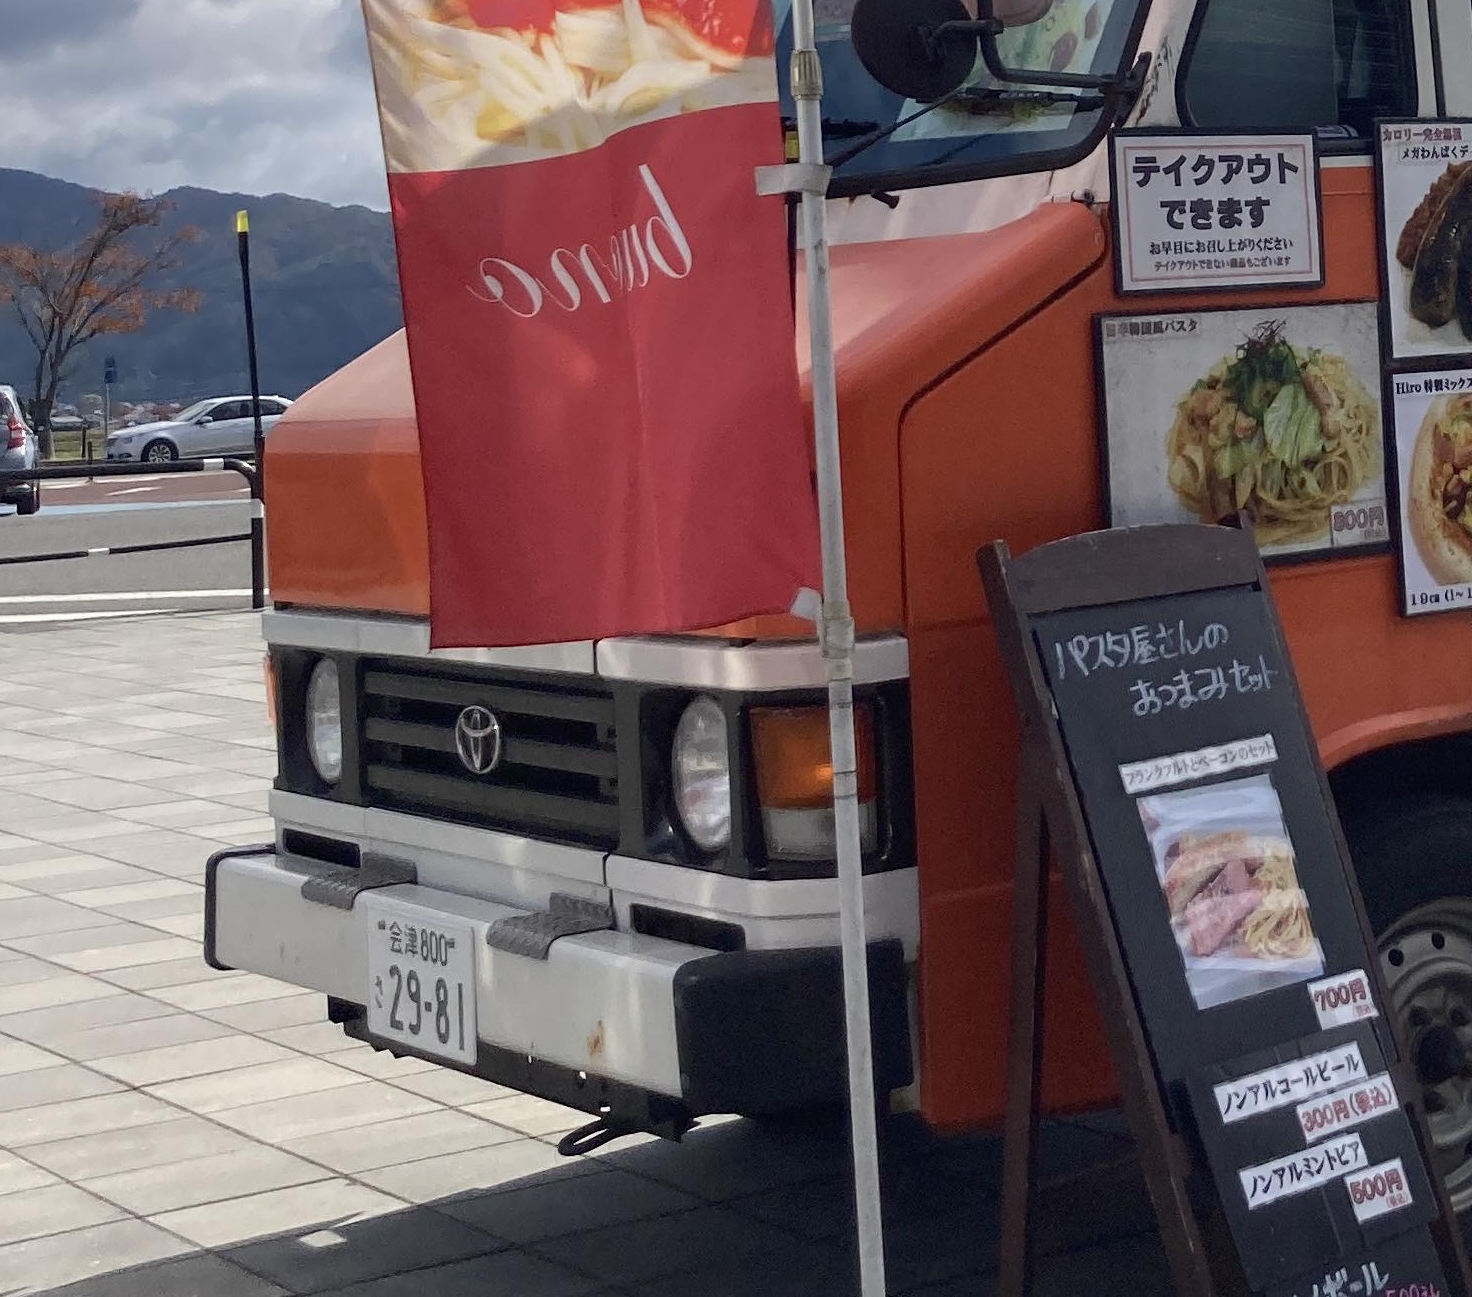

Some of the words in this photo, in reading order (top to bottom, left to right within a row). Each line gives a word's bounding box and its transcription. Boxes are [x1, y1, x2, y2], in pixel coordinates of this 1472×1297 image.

[1132, 152, 1299, 188] テイクアウト
[1160, 196, 1270, 230] できます
[1396, 381, 1421, 395] Hiro
[1055, 619, 1229, 680] パスタ屋さんの
[1130, 655, 1279, 716] おつまみセット
[388, 964, 465, 1052] 29-81
[1313, 978, 1367, 1011] 700円
[1224, 1052, 1361, 1115] ノンアルコールビール
[1250, 1140, 1361, 1198] ノンアルミントビア
[1349, 1167, 1404, 1204] 500円
